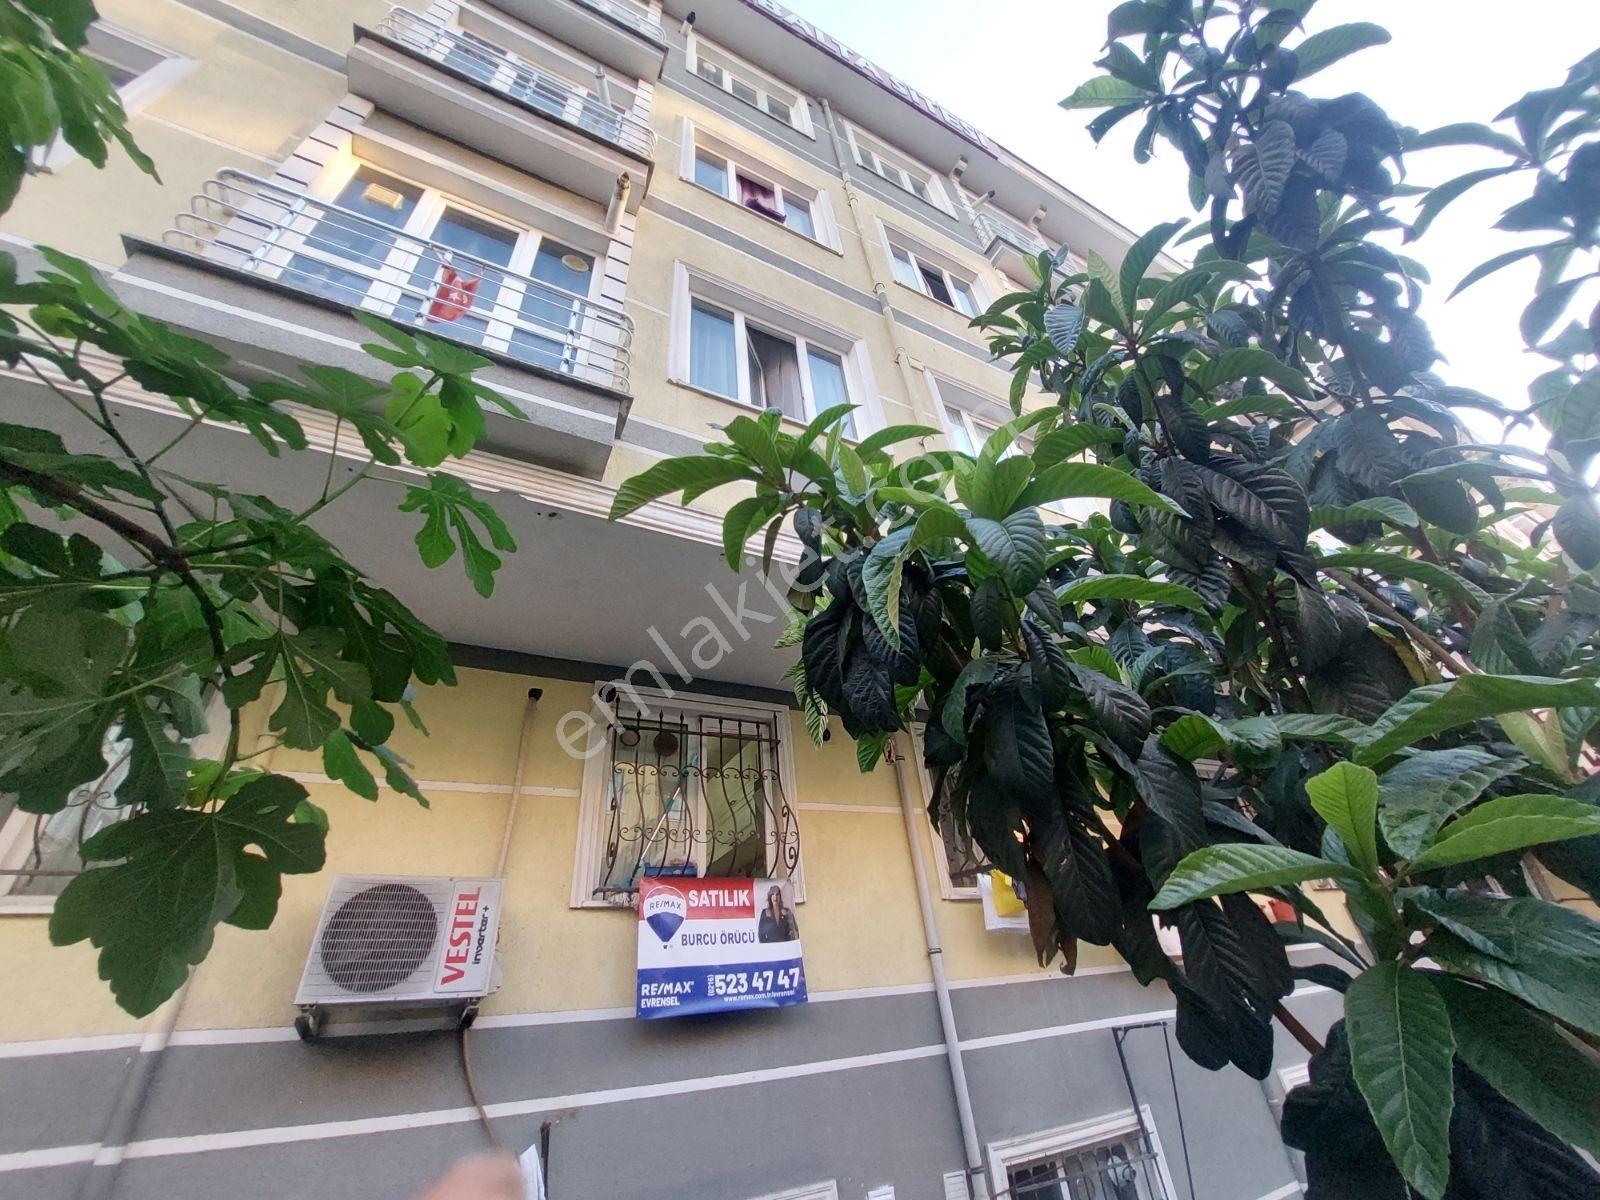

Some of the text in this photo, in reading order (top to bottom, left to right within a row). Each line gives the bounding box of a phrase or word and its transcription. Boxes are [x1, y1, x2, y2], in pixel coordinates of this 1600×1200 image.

[649, 900, 682, 911] RE/MAX
[688, 889, 751, 907] SATILIK
[441, 887, 481, 985] VESTEL
[681, 929, 756, 946] BURCU ÖRÜCÜ
[715, 972, 748, 995] 523
[752, 970, 774, 992] 47
[777, 967, 800, 989] 47
[641, 996, 680, 1008] EVRENSEL
